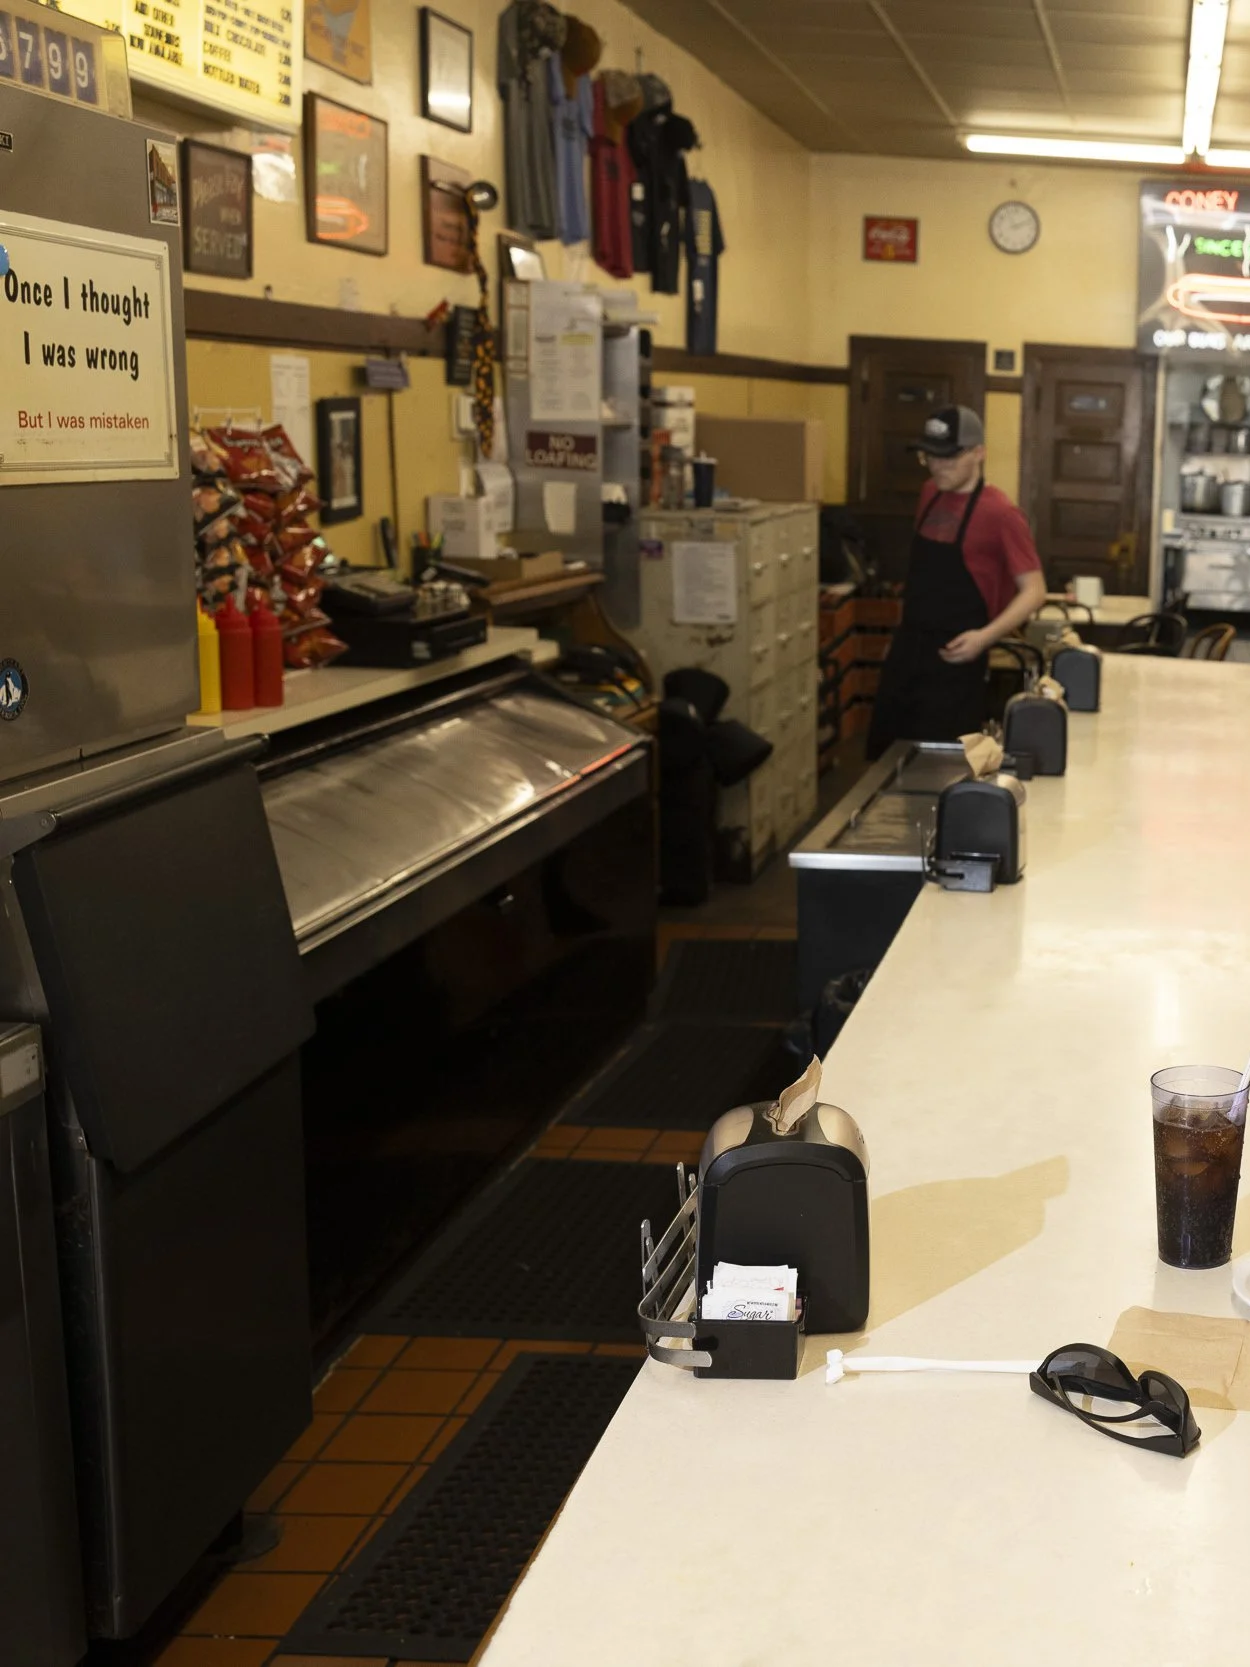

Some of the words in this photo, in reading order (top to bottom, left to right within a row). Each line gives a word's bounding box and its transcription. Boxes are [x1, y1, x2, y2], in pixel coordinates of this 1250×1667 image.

[1165, 190, 1239, 214] CONEY
[5, 268, 52, 307] Once
[64, 276, 69, 309] I
[81, 279, 150, 326] thought
[24, 330, 30, 365] I
[42, 343, 76, 368] was
[86, 347, 139, 381] wrong
[18, 410, 43, 429] But
[48, 411, 52, 428] I
[57, 416, 85, 429] was
[90, 412, 150, 430] mistaken
[549, 435, 576, 451] NO
